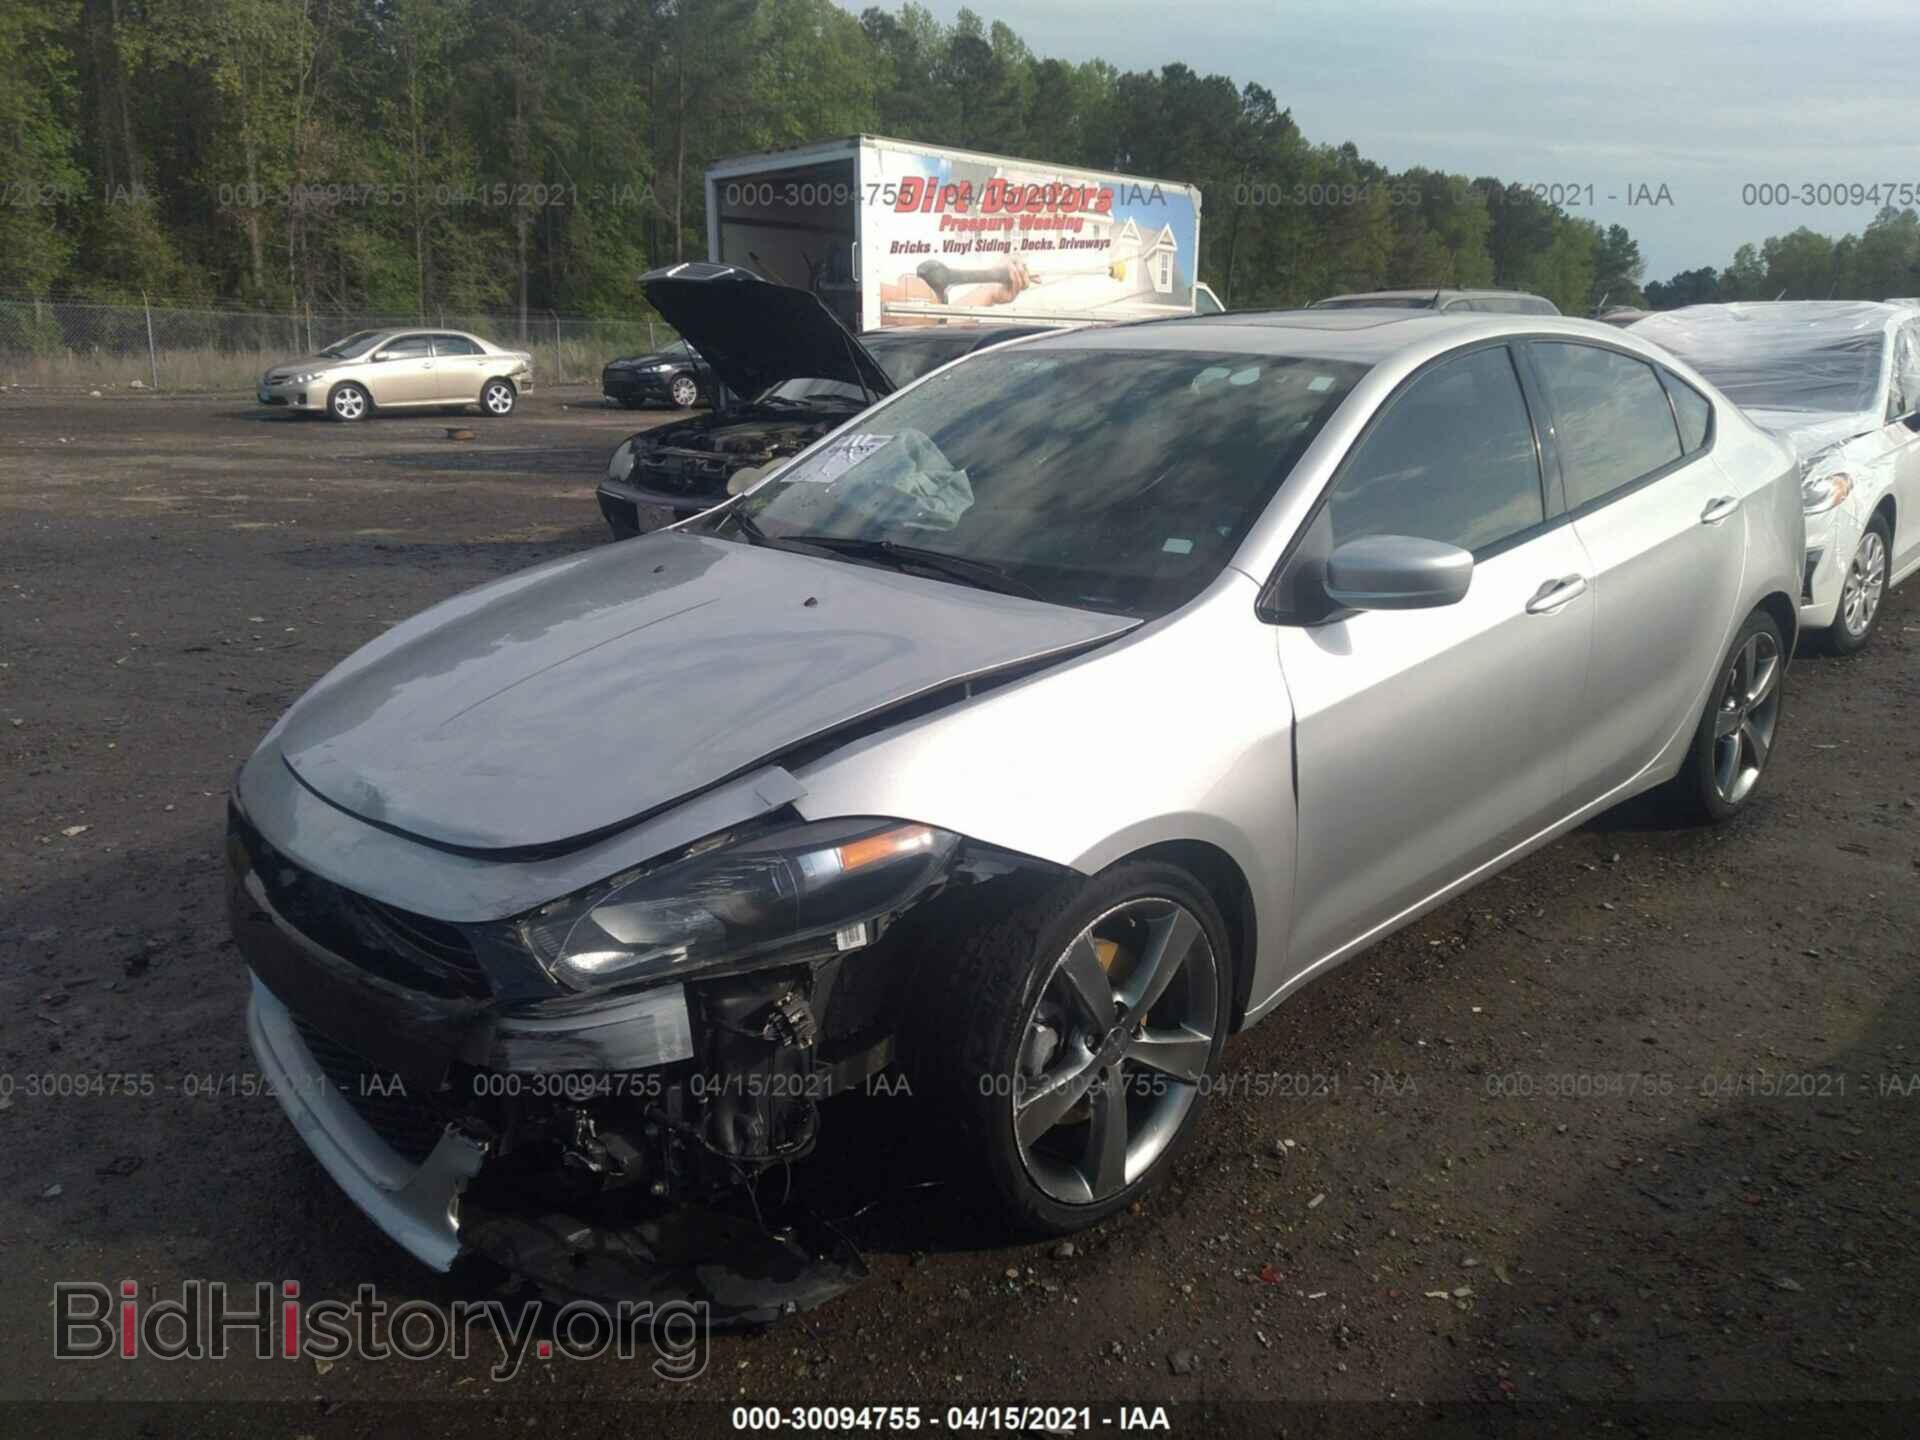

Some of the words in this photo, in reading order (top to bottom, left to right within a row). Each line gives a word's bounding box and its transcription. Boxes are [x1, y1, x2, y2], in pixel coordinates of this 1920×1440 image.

[895, 176, 972, 213] Dirt
[980, 178, 1114, 214] Doctors
[939, 215, 1013, 231] Pressure
[1019, 213, 1084, 233] Washing
[890, 240, 931, 254] Bricks
[943, 239, 972, 255] Vinyl
[975, 238, 1011, 254] Siding
